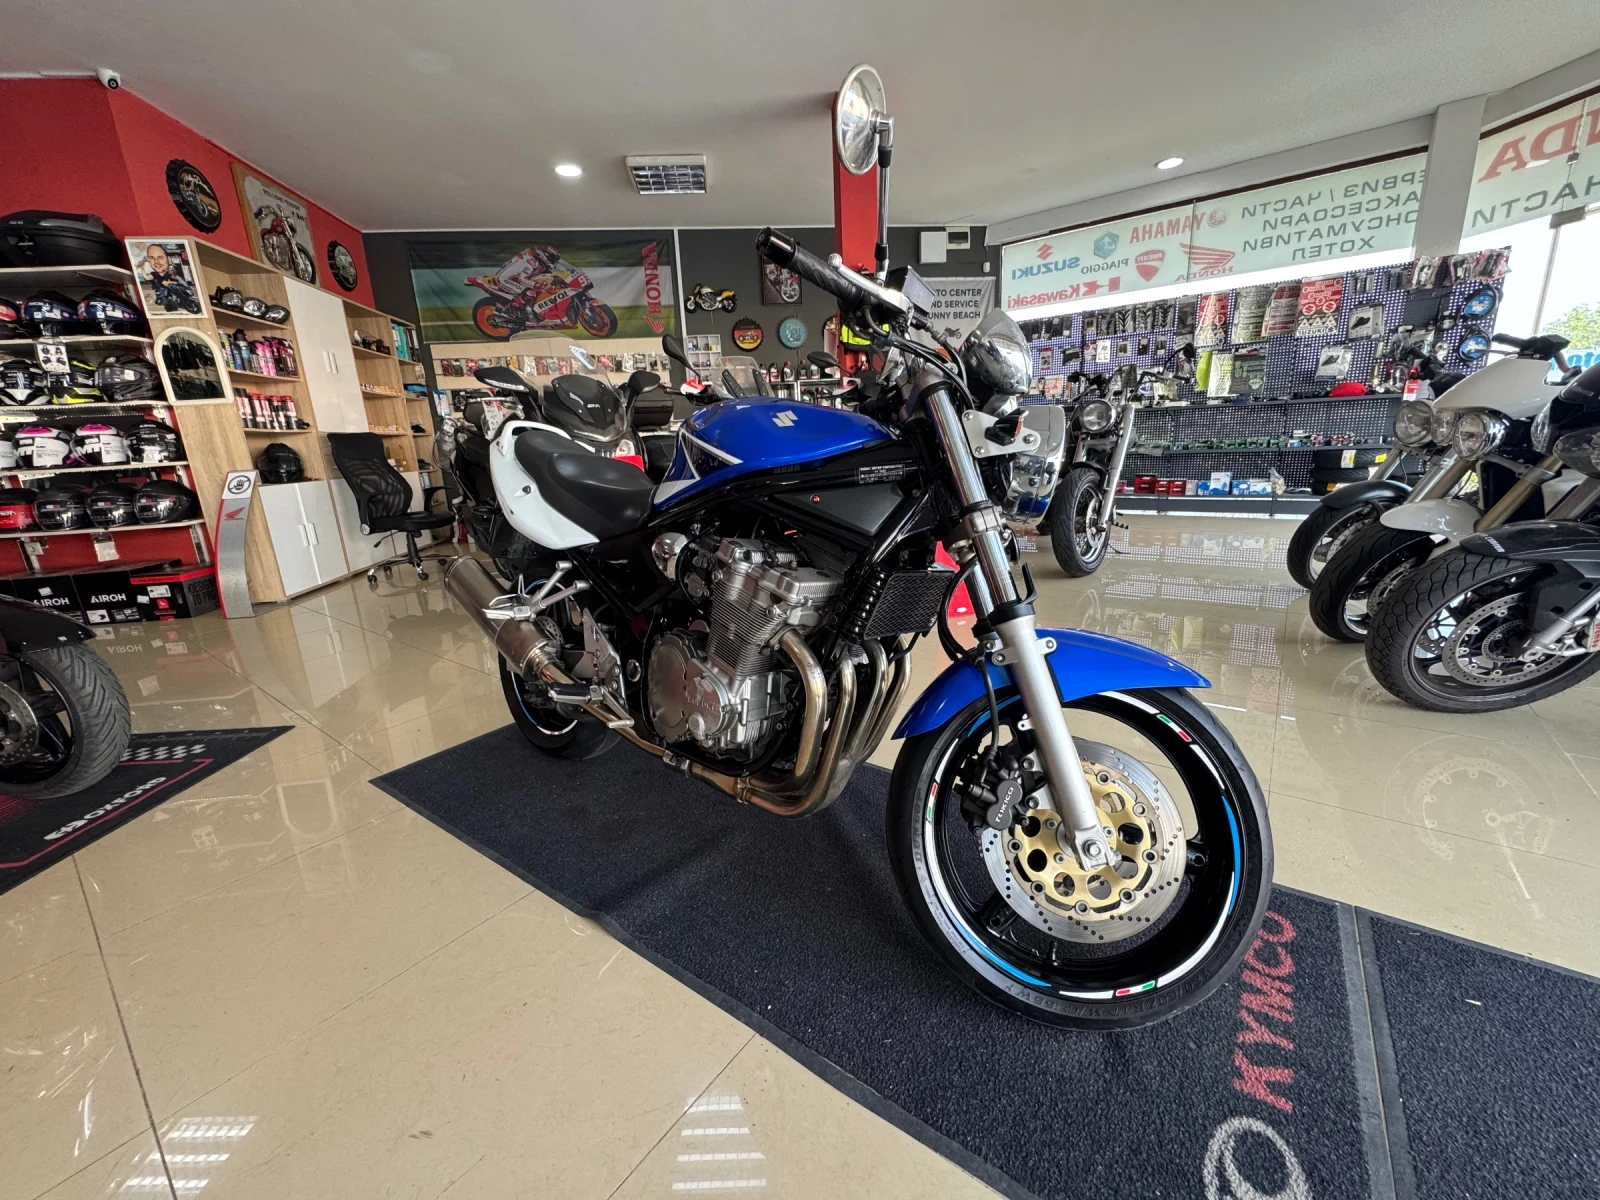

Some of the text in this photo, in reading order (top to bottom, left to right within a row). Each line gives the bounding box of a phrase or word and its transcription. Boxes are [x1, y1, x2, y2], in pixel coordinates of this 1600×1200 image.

[641, 242, 662, 316] HONDA
[934, 288, 982, 297] TO CENTER
[930, 299, 979, 309] ND SERVICE
[926, 311, 981, 320] UNNY BEACH
[90, 592, 127, 604] AIROH
[994, 787, 1014, 823] TOKICO
[1233, 910, 1296, 1114] KYMCO
